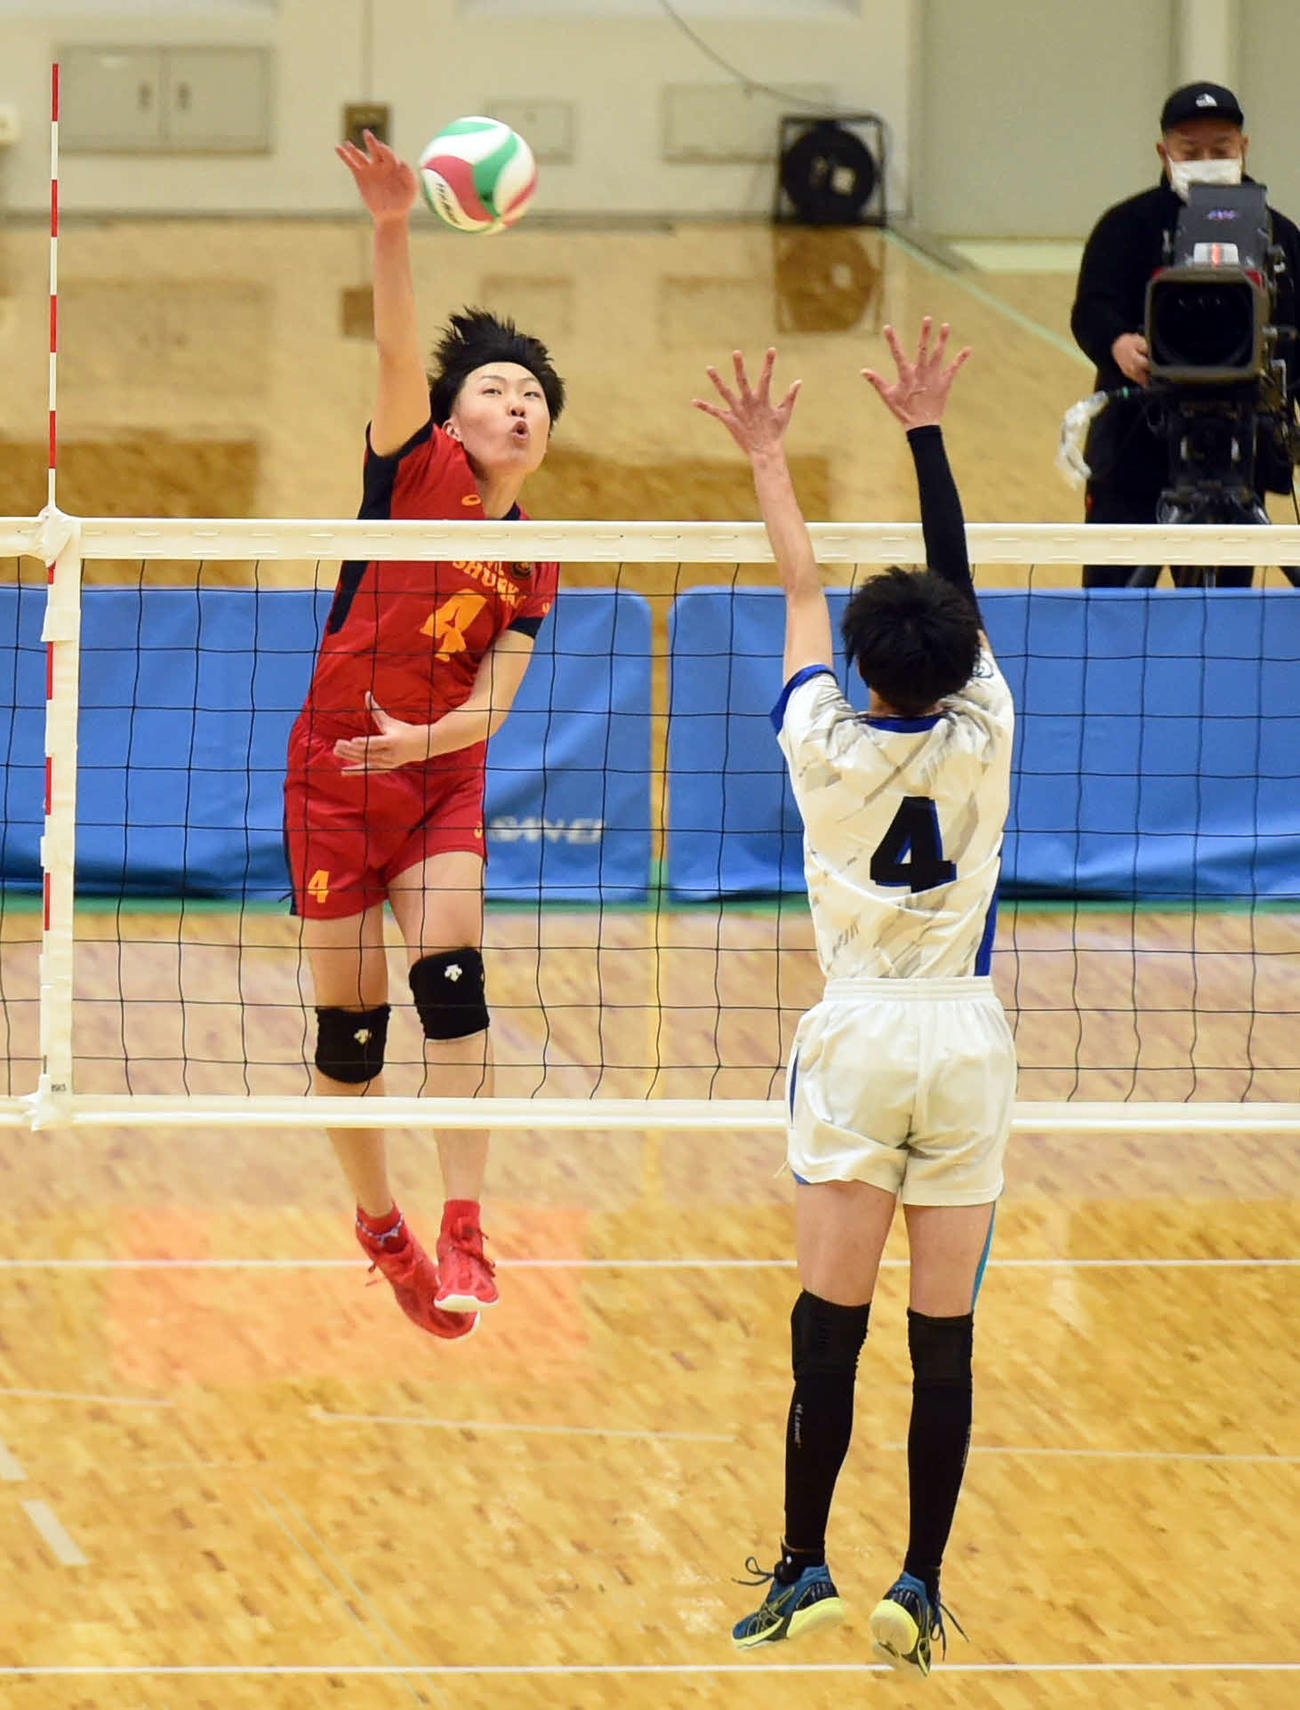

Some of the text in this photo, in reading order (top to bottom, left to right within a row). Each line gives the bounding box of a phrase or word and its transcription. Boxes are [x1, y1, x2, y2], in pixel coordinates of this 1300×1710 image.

[420, 588, 488, 662] 4
[870, 796, 958, 893] 4
[308, 870, 329, 904] 4
